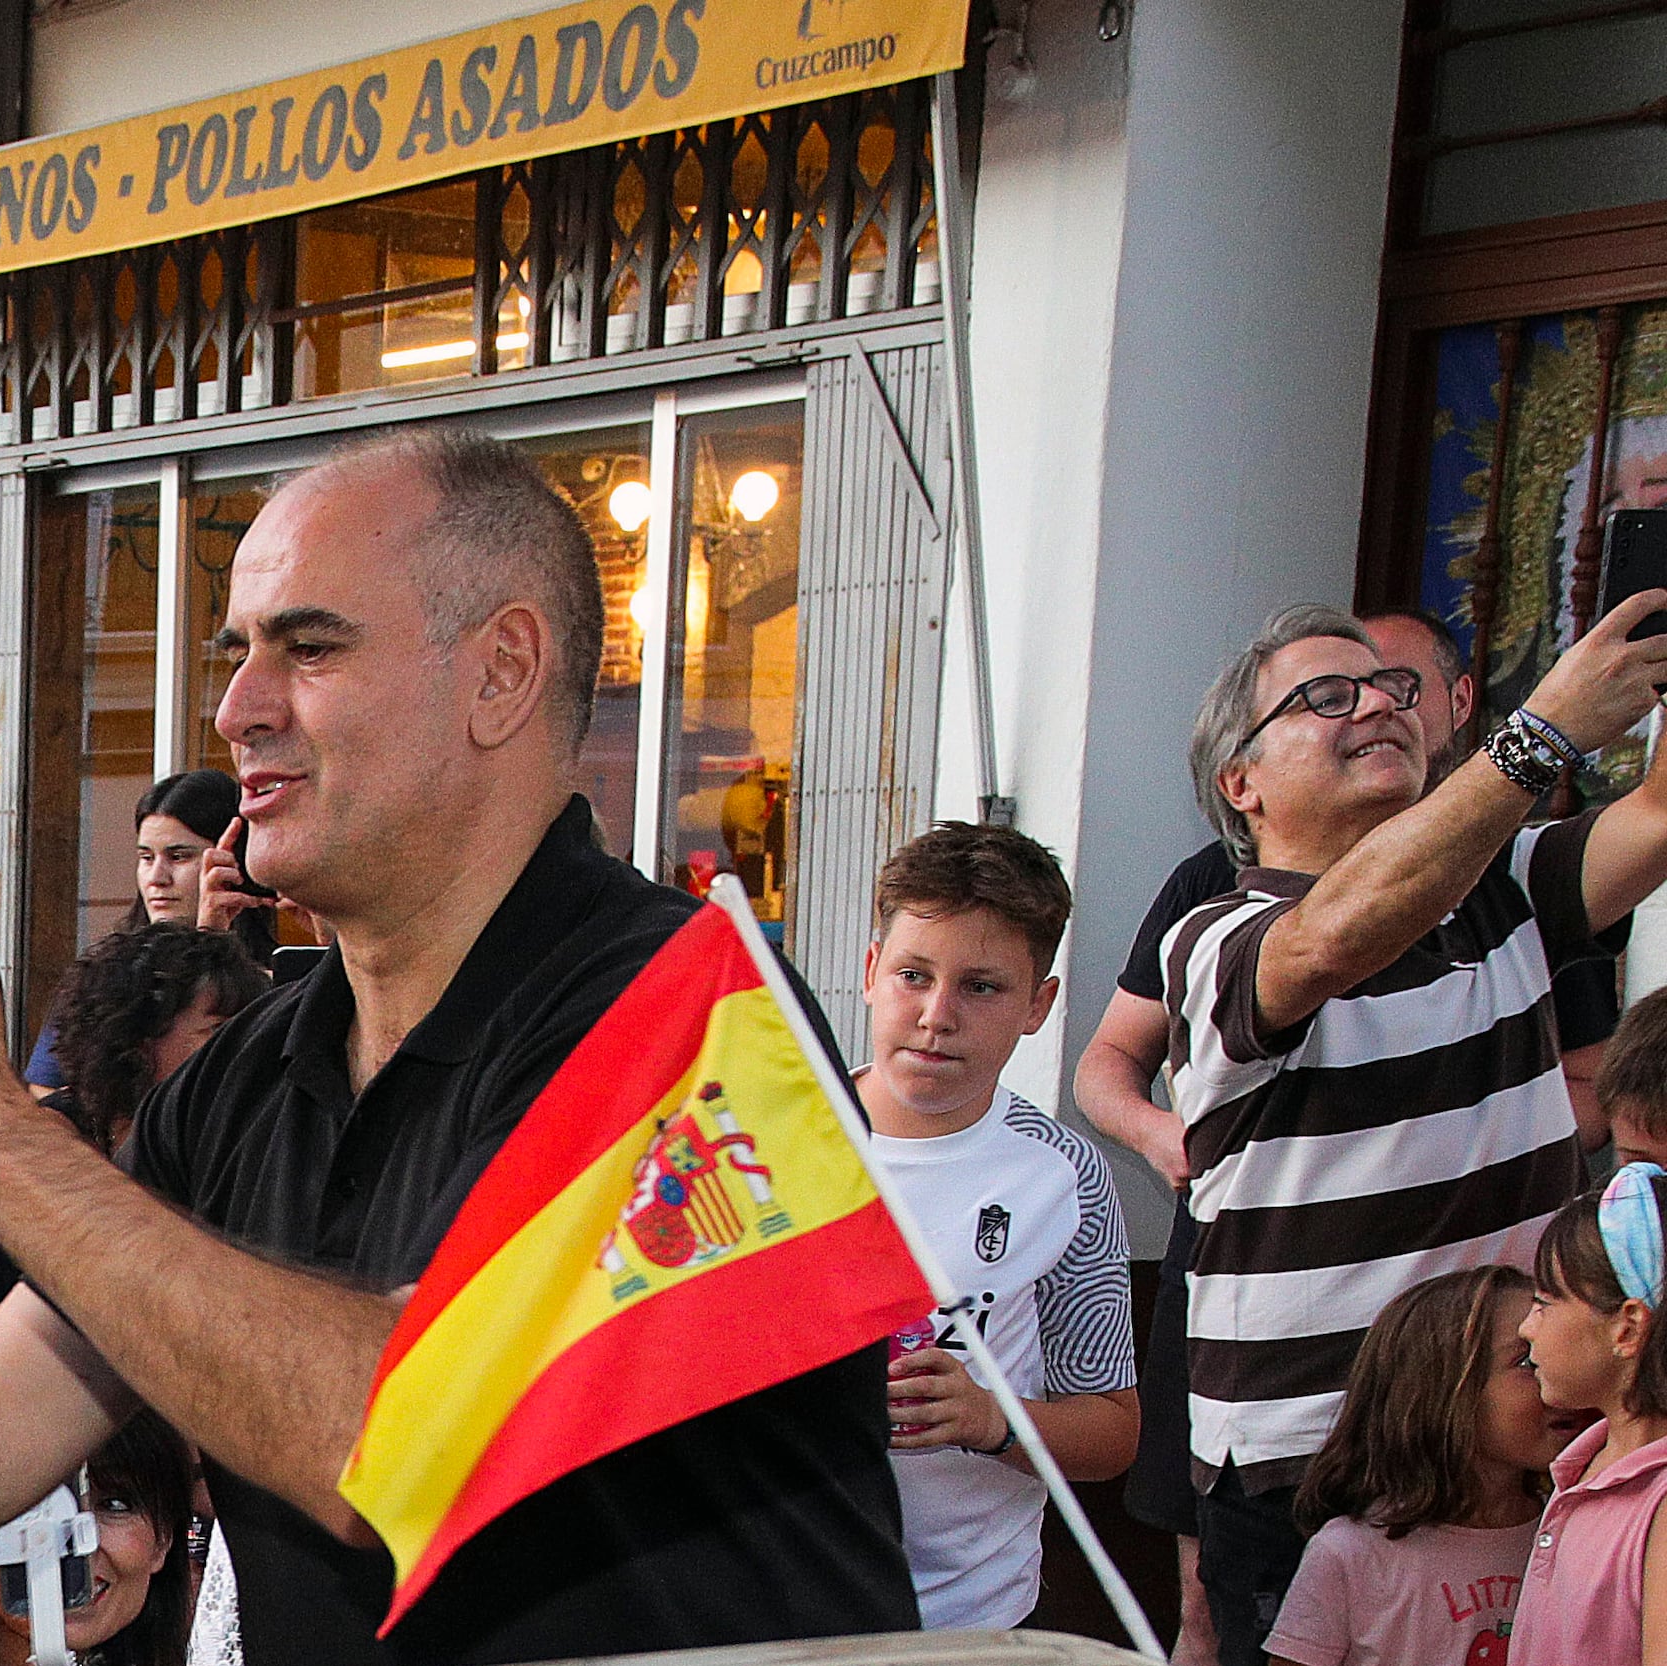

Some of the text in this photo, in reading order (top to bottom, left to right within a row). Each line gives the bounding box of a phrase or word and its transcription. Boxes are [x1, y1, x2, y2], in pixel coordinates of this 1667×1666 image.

[757, 32, 897, 89] Cruzcampo
[147, 72, 387, 215] POLLOS
[398, 0, 707, 162] ASADOS
[1440, 1574, 1522, 1624] LITT
